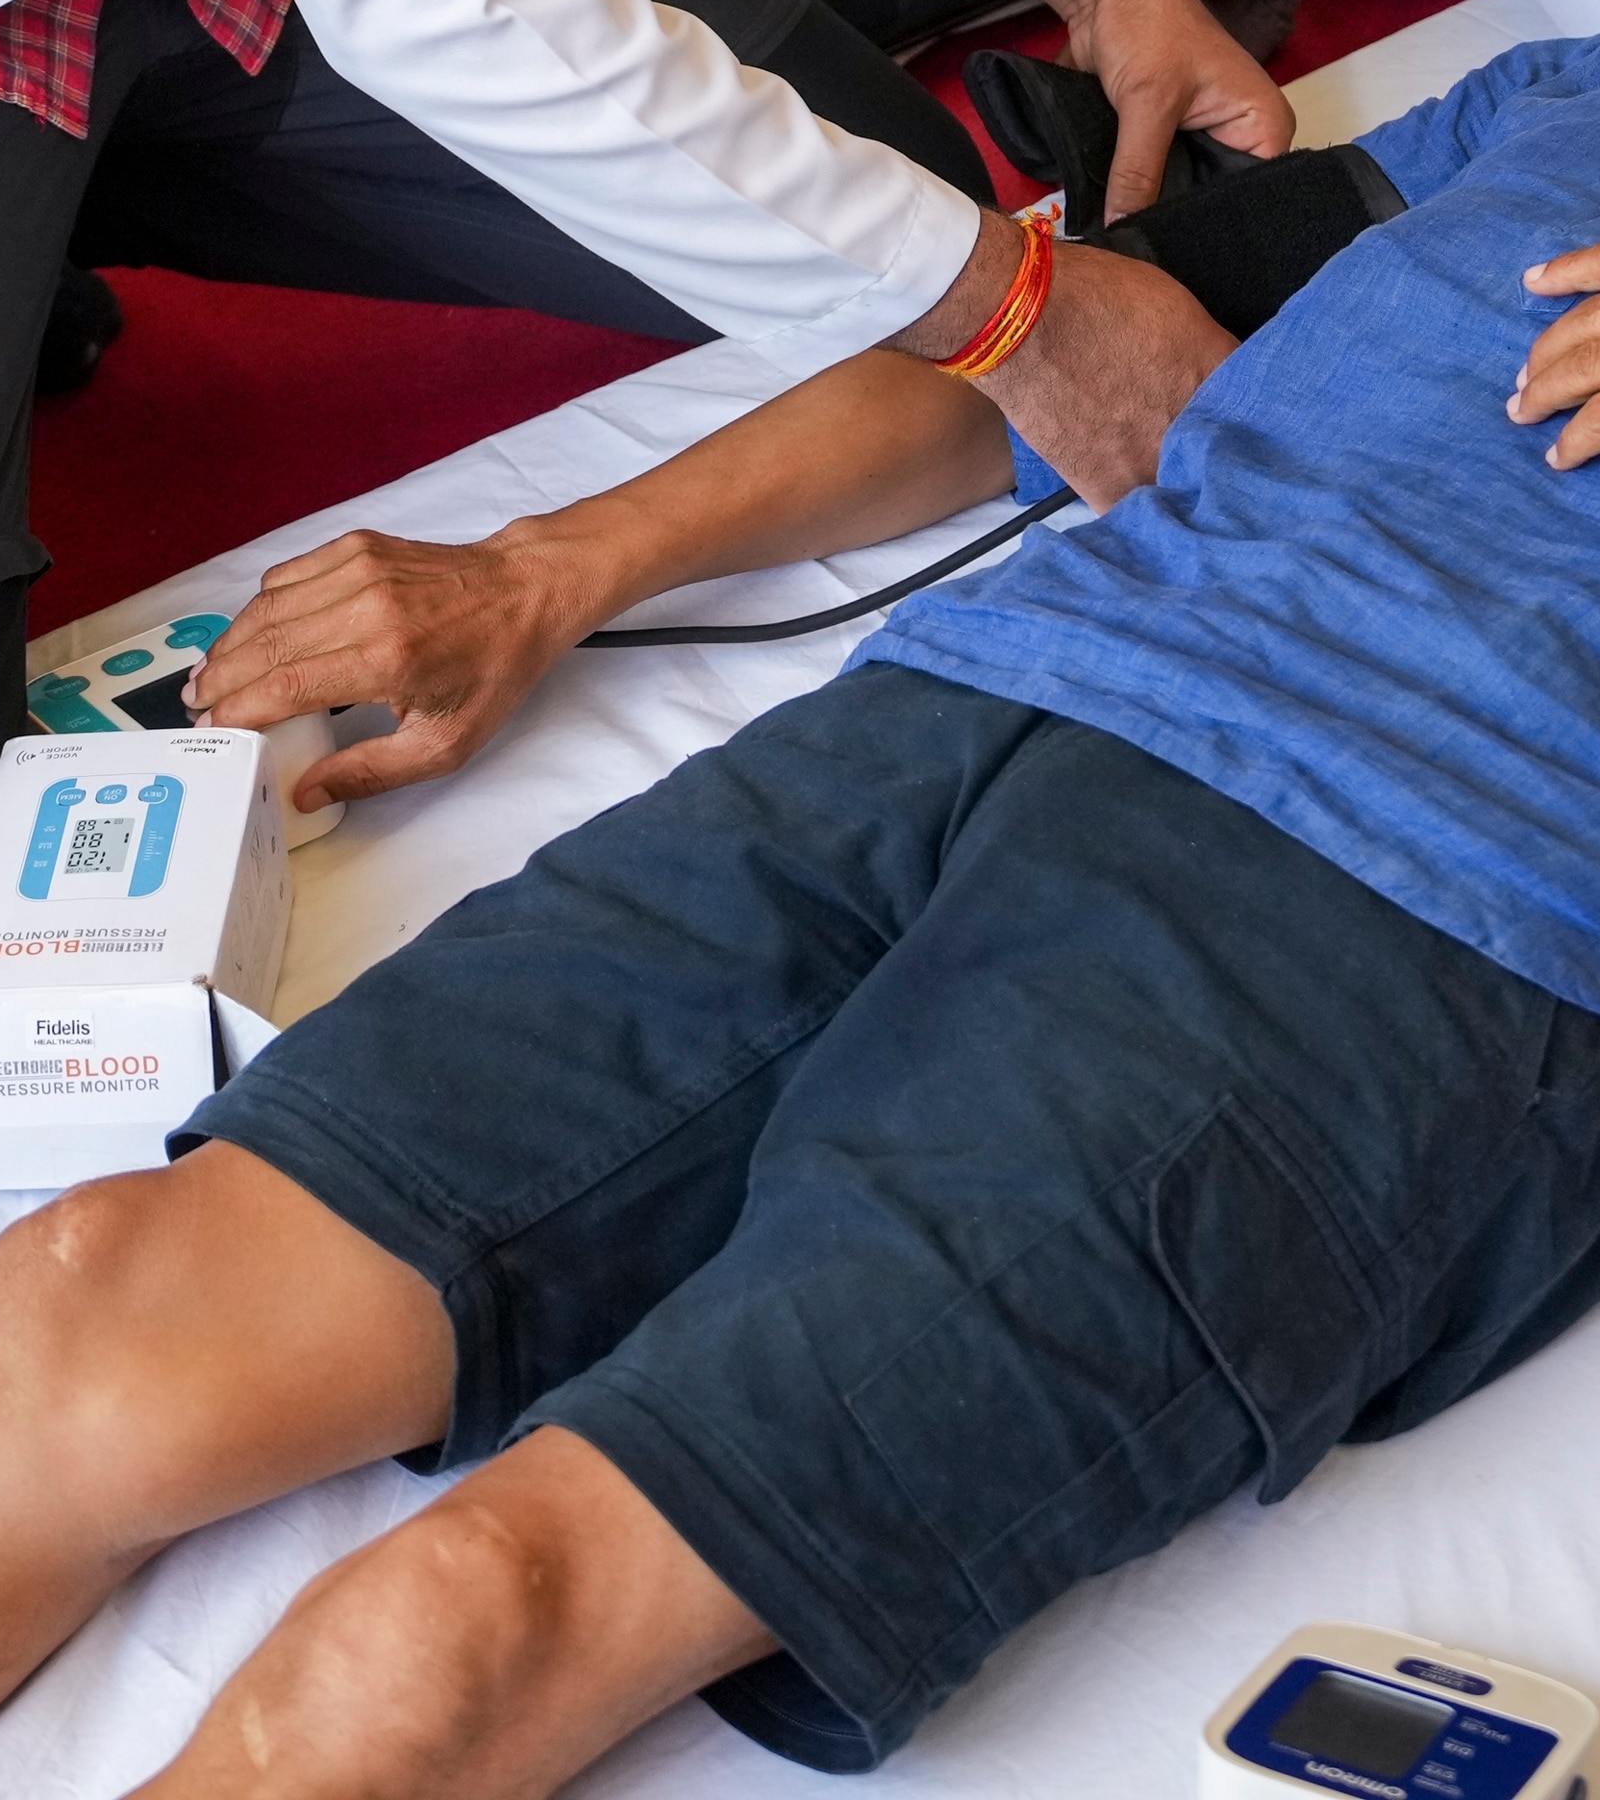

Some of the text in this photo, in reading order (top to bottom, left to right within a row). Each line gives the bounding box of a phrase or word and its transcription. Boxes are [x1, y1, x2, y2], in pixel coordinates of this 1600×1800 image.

[39, 745, 83, 754] REPORT
[46, 752, 78, 760] VOICE
[72, 833, 103, 849] 80
[67, 851, 106, 867] 120
[74, 928, 167, 938] PRESSURE
[81, 942, 164, 953] ELECTRONIC
[36, 1020, 90, 1036] Fidelis
[34, 1038, 93, 1046] HEALTHCARE
[65, 1056, 160, 1077] BLOOD
[80, 1078, 160, 1093] MONITOR
[1305, 1760, 1407, 1800] OMRON
